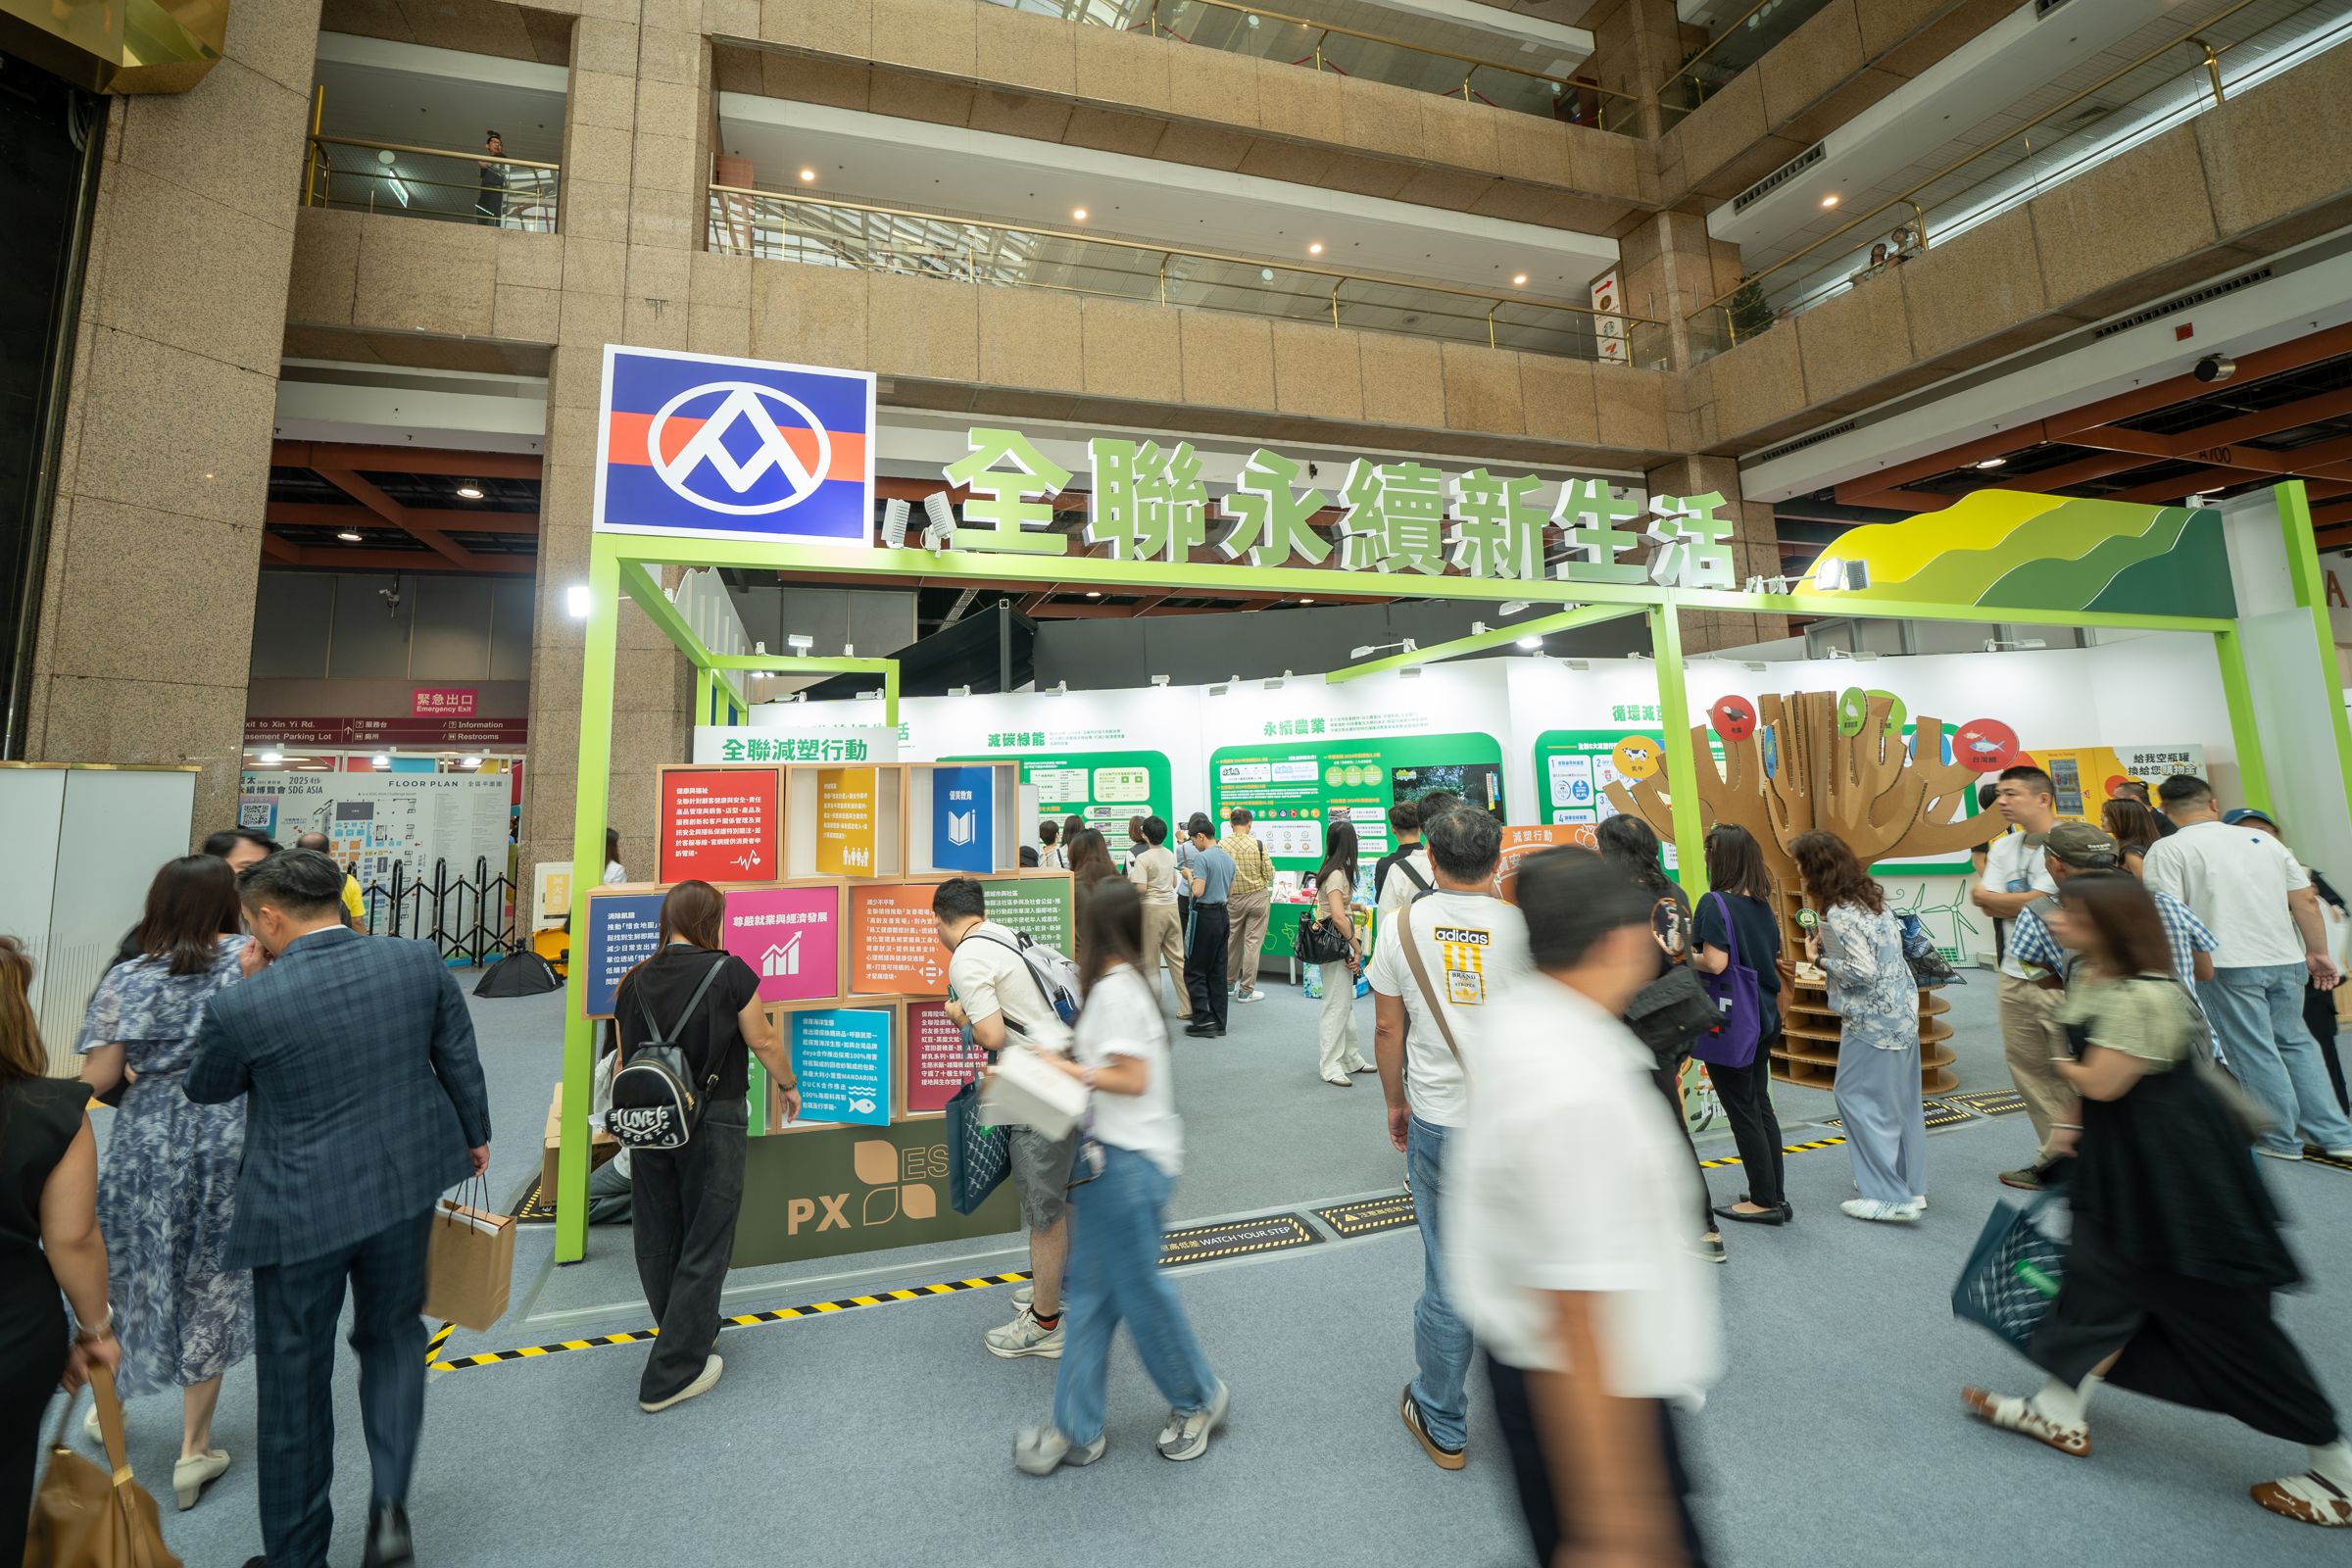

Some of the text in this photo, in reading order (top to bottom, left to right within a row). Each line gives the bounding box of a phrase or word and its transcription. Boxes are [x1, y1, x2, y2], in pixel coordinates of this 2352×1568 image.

[943, 427, 1736, 591] 全聯永續新生活
[2327, 569, 2349, 609] A
[416, 693, 472, 706] 緊急出口
[1264, 717, 1326, 736] 永續農業
[283, 733, 315, 742] Parking
[988, 731, 1046, 748] 減碳綠能
[721, 738, 867, 761] 全聯減塑行動
[2133, 752, 2190, 764] 給我空瓶罐
[288, 786, 323, 795] SDG ASIA
[950, 790, 973, 801] 優質教育
[1512, 830, 1553, 844] 減塑行動
[732, 911, 828, 927] 尊嚴就業與經濟發展
[1436, 929, 1488, 945] adidas
[606, 943, 660, 953] 減少日常支出更
[622, 1109, 656, 1128] LOVE
[902, 1144, 950, 1182] ES
[787, 1193, 852, 1235] PX
[1200, 1233, 1237, 1247] WATCH
[1237, 1229, 1268, 1241] YOUR
[1269, 1226, 1291, 1237] STEP
